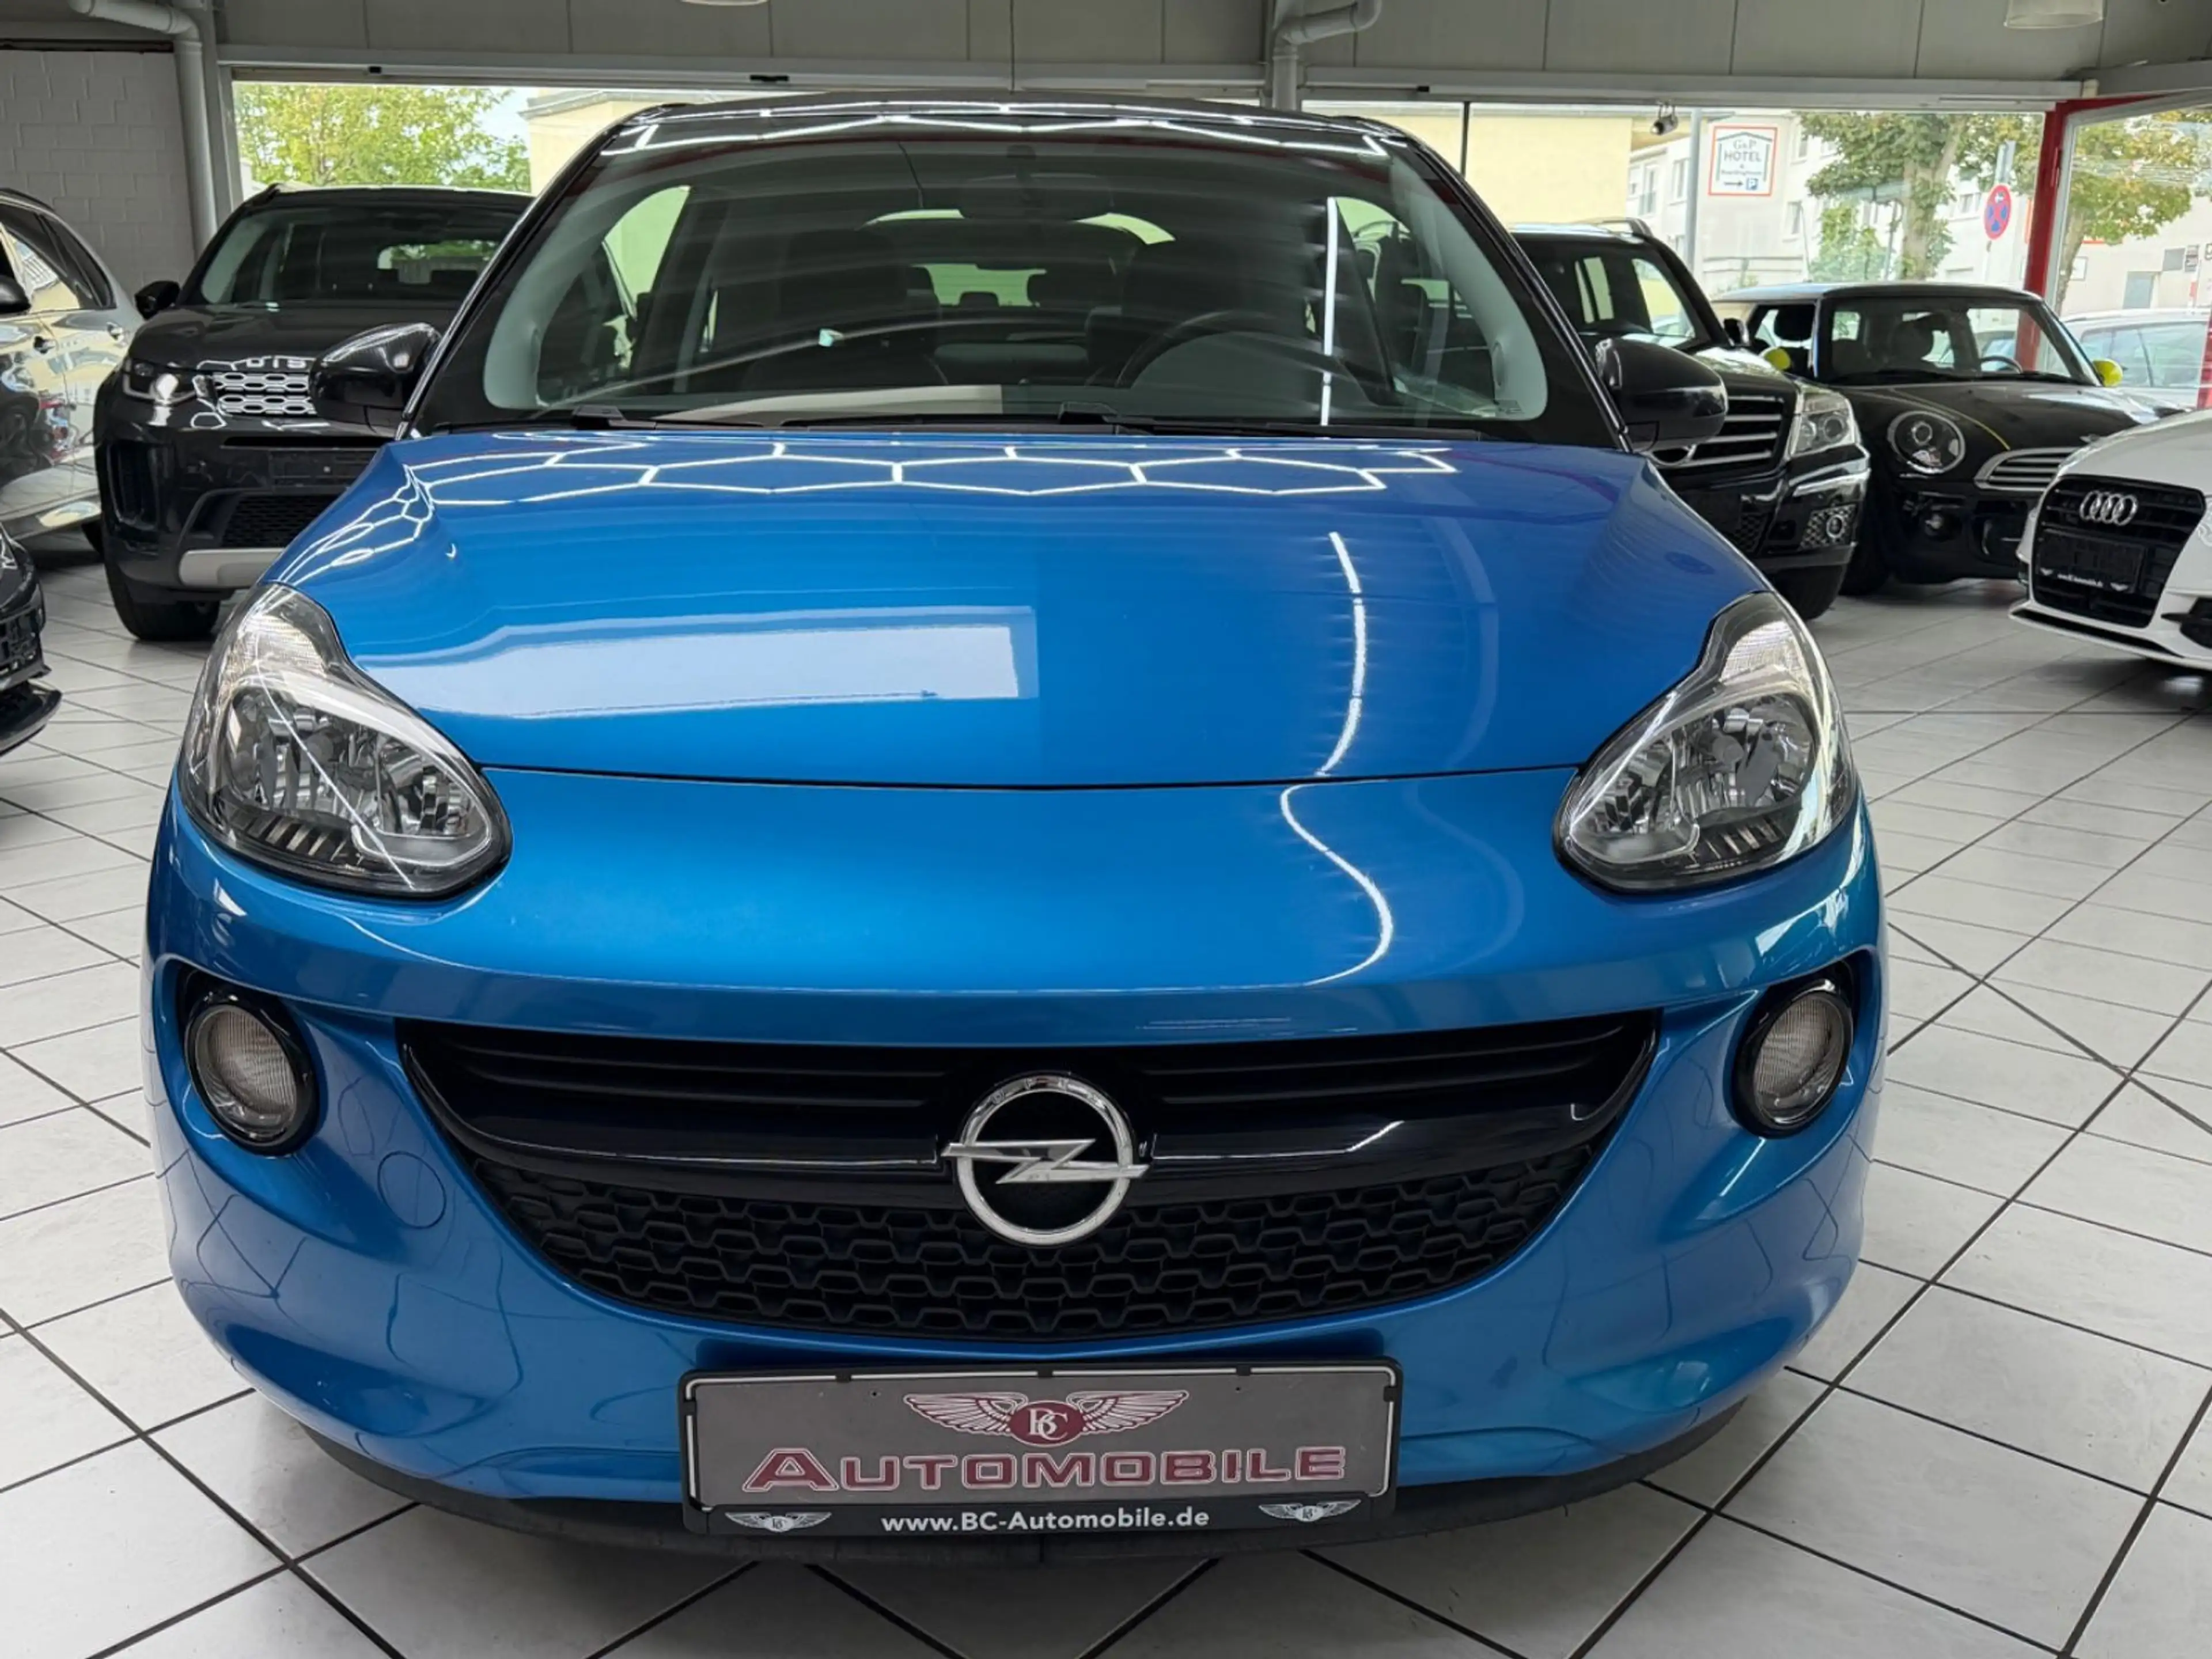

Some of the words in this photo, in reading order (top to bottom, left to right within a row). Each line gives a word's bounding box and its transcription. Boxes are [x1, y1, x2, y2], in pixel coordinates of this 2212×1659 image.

[1724, 150, 1762, 162] HOTEL
[742, 1446, 1346, 1493] AUTOMOBILE
[881, 1506, 1210, 1532] www.BC-Automobile.de
